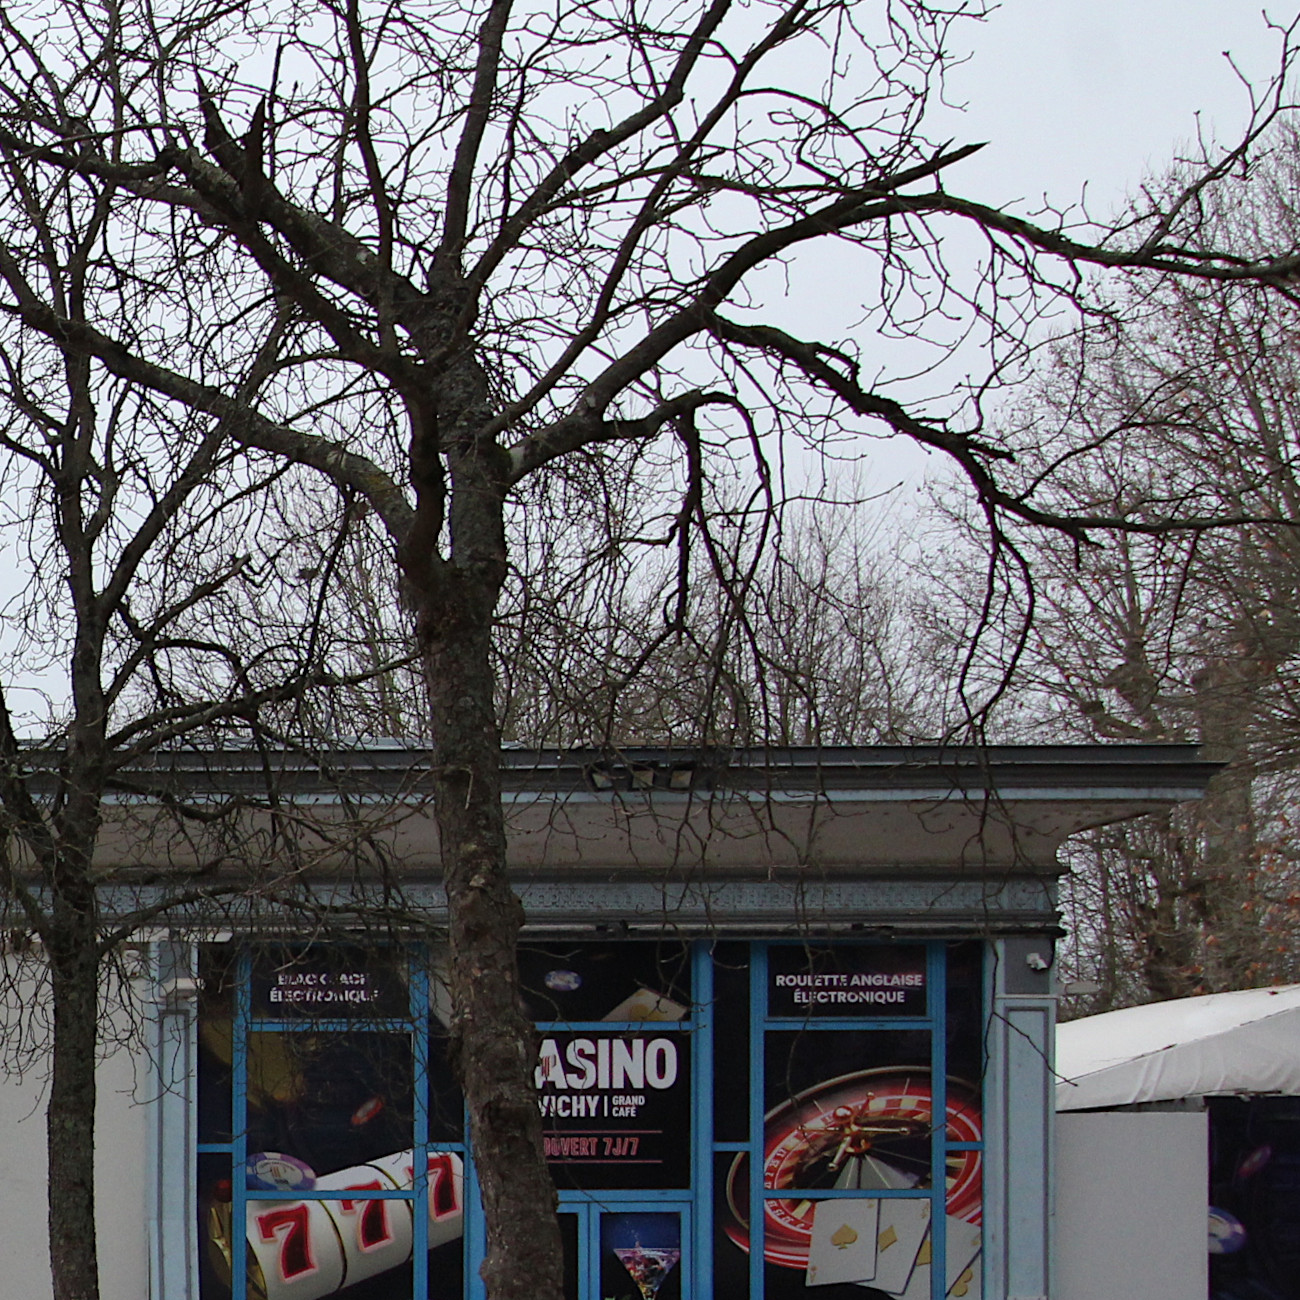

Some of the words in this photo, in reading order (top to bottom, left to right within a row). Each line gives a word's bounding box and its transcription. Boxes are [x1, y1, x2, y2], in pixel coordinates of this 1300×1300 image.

[775, 974, 847, 987] ROULETTE
[850, 974, 922, 987] ANGLAISE
[534, 1037, 678, 1090] ASINO
[538, 1095, 600, 1118] VICHY
[612, 1095, 646, 1106] GRAND
[612, 1104, 637, 1117] CAFÉ
[543, 1137, 599, 1157] OUVERT
[602, 1137, 641, 1156] 7J/7
